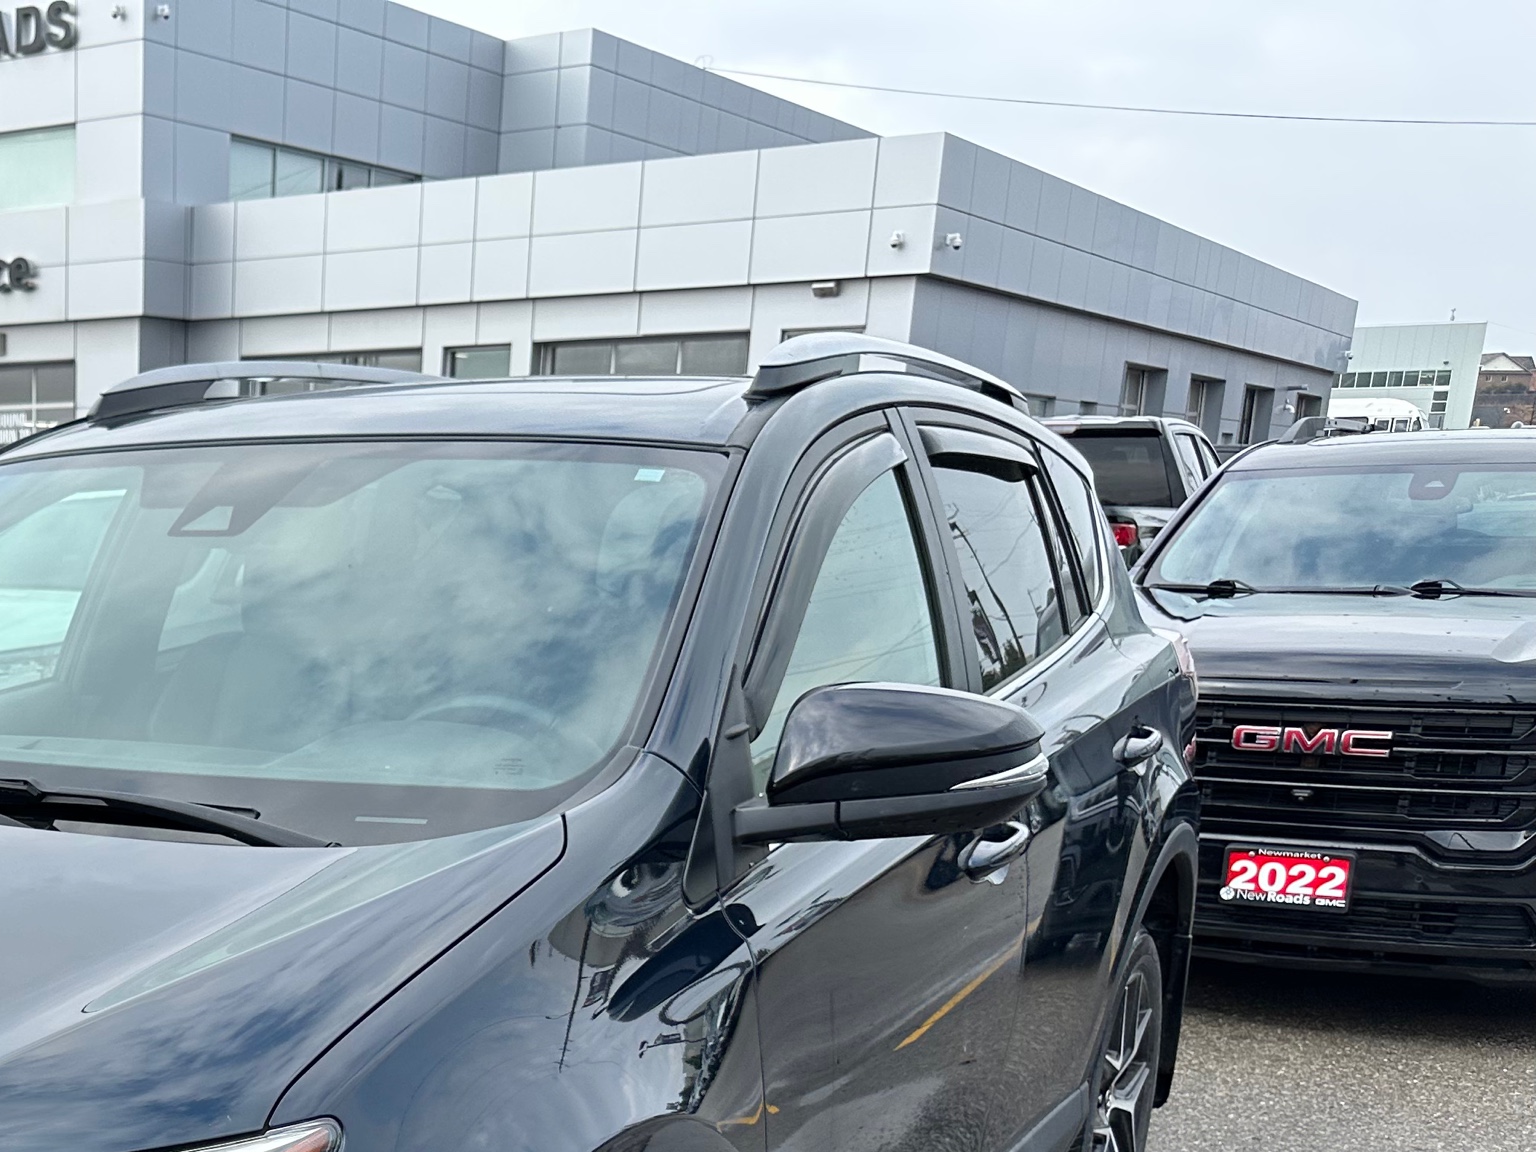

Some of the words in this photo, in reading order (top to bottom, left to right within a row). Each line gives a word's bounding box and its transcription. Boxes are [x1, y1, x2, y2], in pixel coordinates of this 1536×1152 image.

[1232, 724, 1393, 758] GMC
[1258, 848, 1322, 860] Newmarket
[1228, 859, 1346, 898] 2022
[1236, 888, 1311, 906] NewRoads
[1315, 898, 1346, 907] GMC
